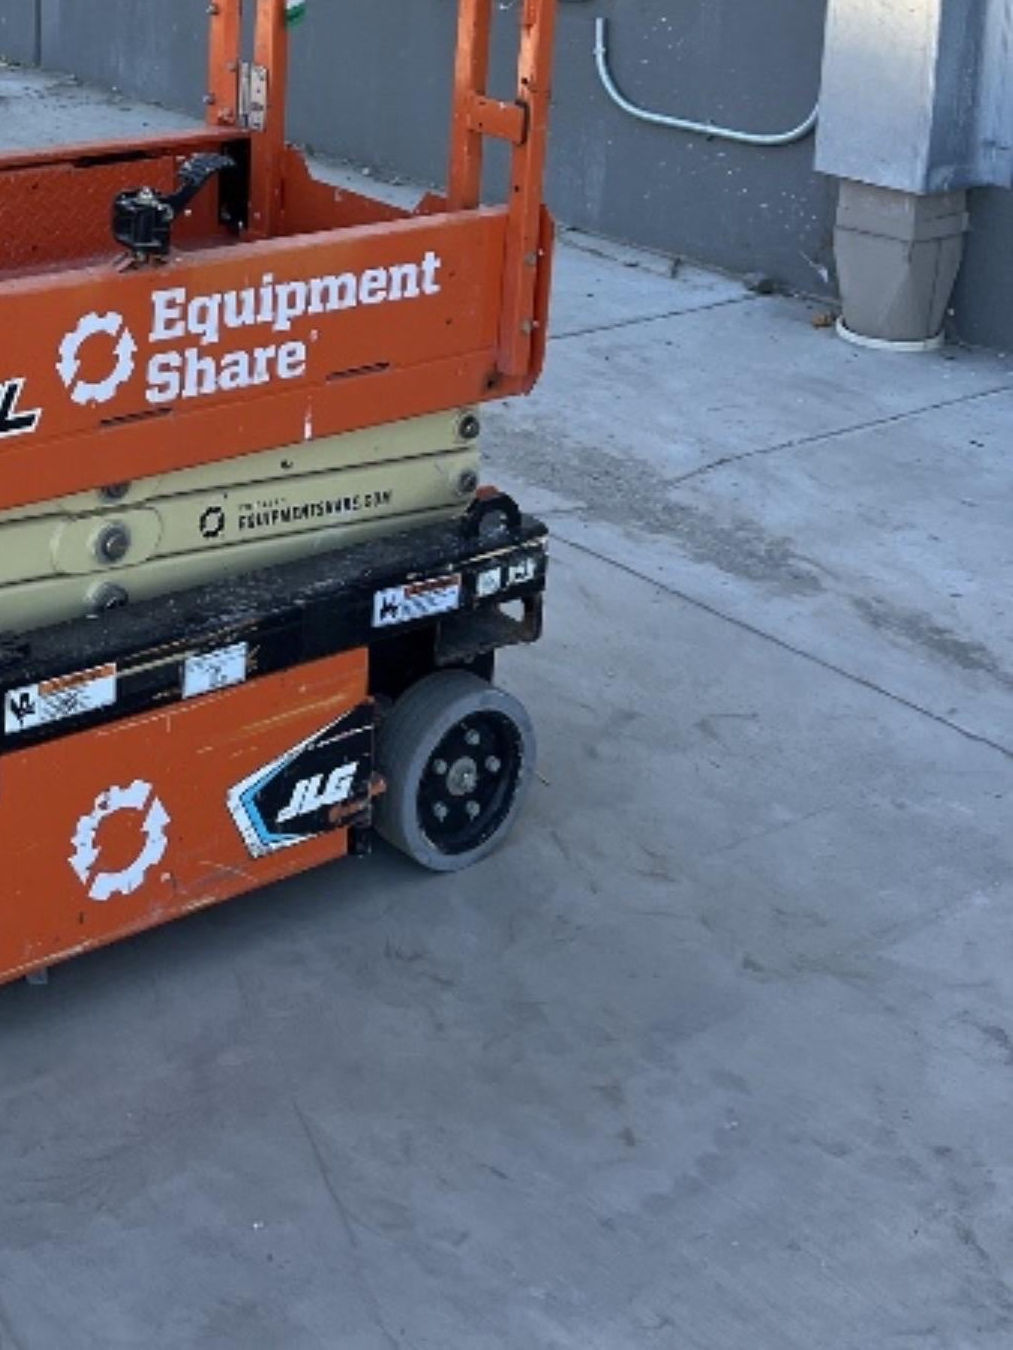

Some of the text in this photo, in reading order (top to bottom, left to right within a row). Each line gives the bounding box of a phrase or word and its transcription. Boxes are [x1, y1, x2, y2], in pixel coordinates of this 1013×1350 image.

[148, 250, 442, 345] Equipment
[145, 339, 307, 403] Share
[276, 761, 359, 823] JLG
